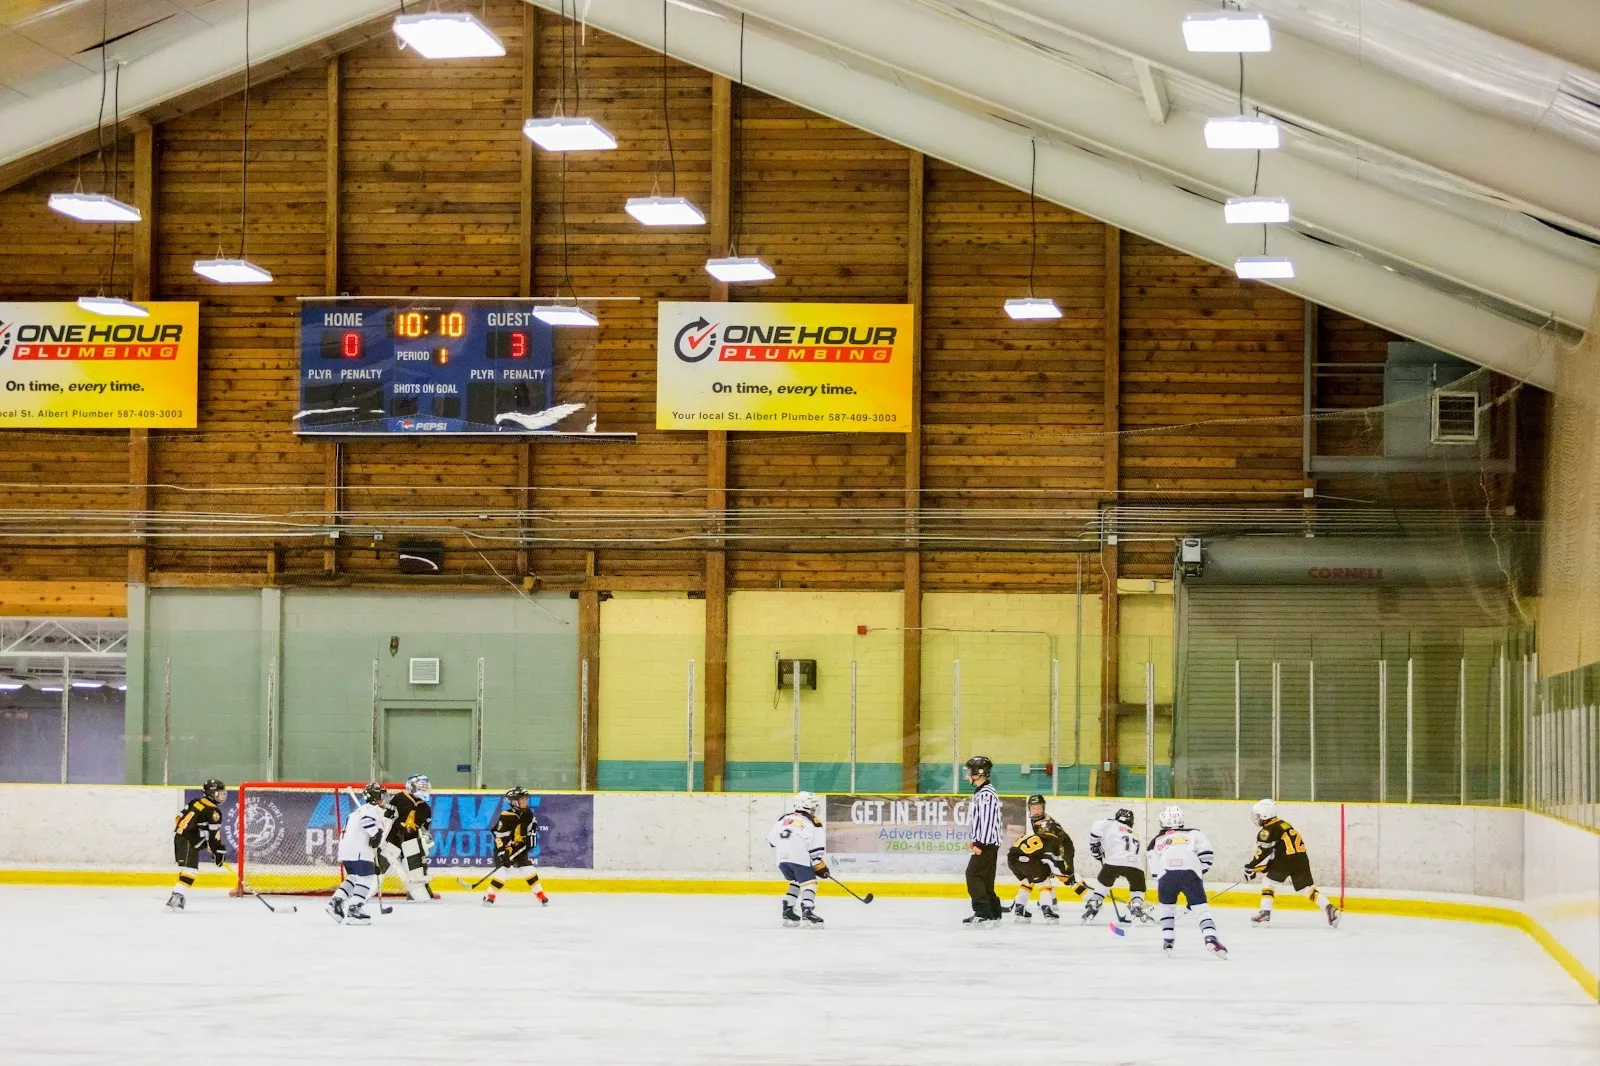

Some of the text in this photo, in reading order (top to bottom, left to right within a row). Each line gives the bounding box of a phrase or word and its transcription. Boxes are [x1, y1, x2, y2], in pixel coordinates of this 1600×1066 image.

[324, 313, 363, 326] HOME
[487, 312, 531, 326] GUEST
[17, 324, 183, 342] ONE HOUR
[723, 325, 897, 345] ONE HOUR
[344, 333, 358, 357] 0
[512, 333, 525, 357] 3
[17, 347, 174, 358] PLUMBING
[396, 351, 430, 361] PERIOD
[440, 348, 447, 364] 1
[724, 348, 887, 361] PLUMBING
[308, 369, 382, 379] PLYR PENALTY
[470, 369, 545, 380] PLYR PENALTY
[6, 380, 144, 394] On time, every time.
[393, 384, 458, 394] SHOTS ON GOAL
[712, 381, 857, 397] On time, every time.
[21, 409, 34, 418] St.
[38, 409, 68, 418] Albert
[72, 409, 113, 418] Plumber
[117, 409, 183, 418] 587-409-3003
[672, 411, 897, 422] Your local St. Albert Plumber 587-409-3003
[415, 422, 448, 431] PEPSI
[851, 800, 885, 826] GET
[890, 801, 909, 826] IN
[915, 801, 948, 826] THE
[878, 828, 941, 840] Advertise
[886, 841, 969, 852] 780-418-6054
[1281, 828, 1306, 855] 12
